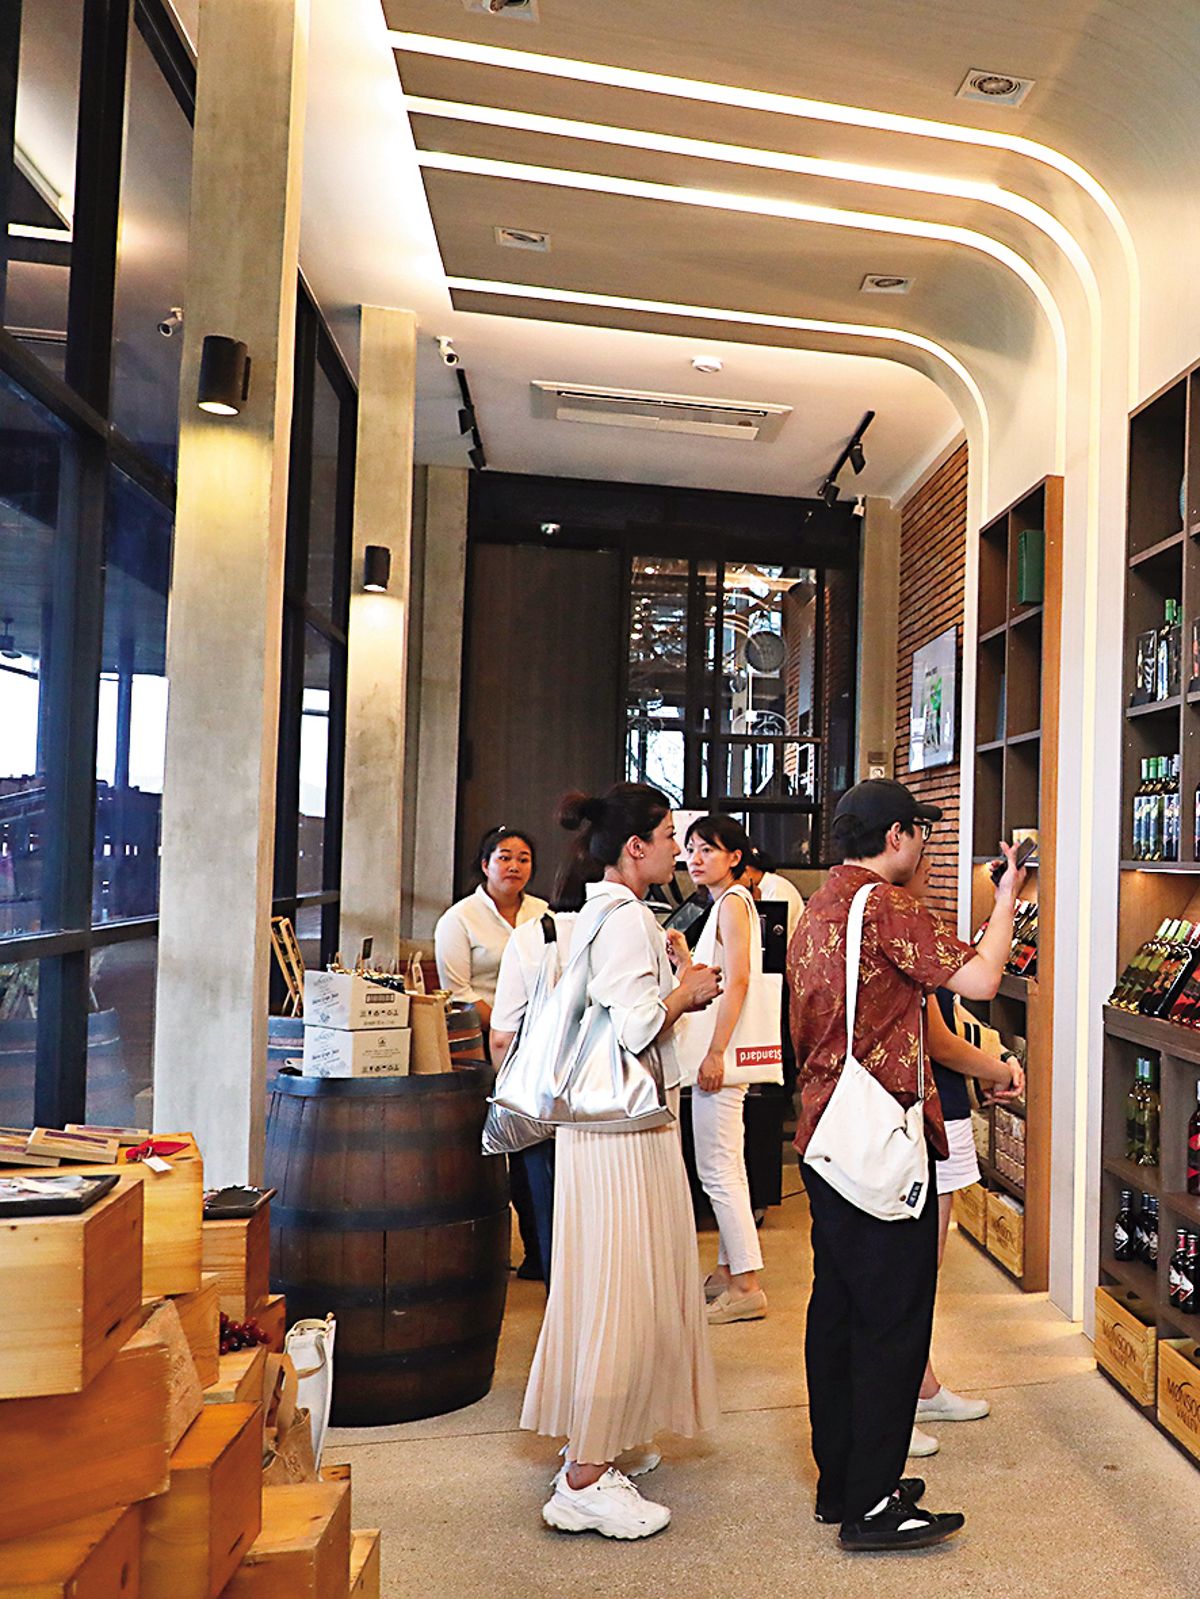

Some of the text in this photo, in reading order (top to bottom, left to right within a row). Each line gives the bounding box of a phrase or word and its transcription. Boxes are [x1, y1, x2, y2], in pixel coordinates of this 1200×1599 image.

[740, 1049, 782, 1063] Standard
[1102, 1321, 1137, 1362] MONSOON
[1176, 1404, 1199, 1434] VALLEY
